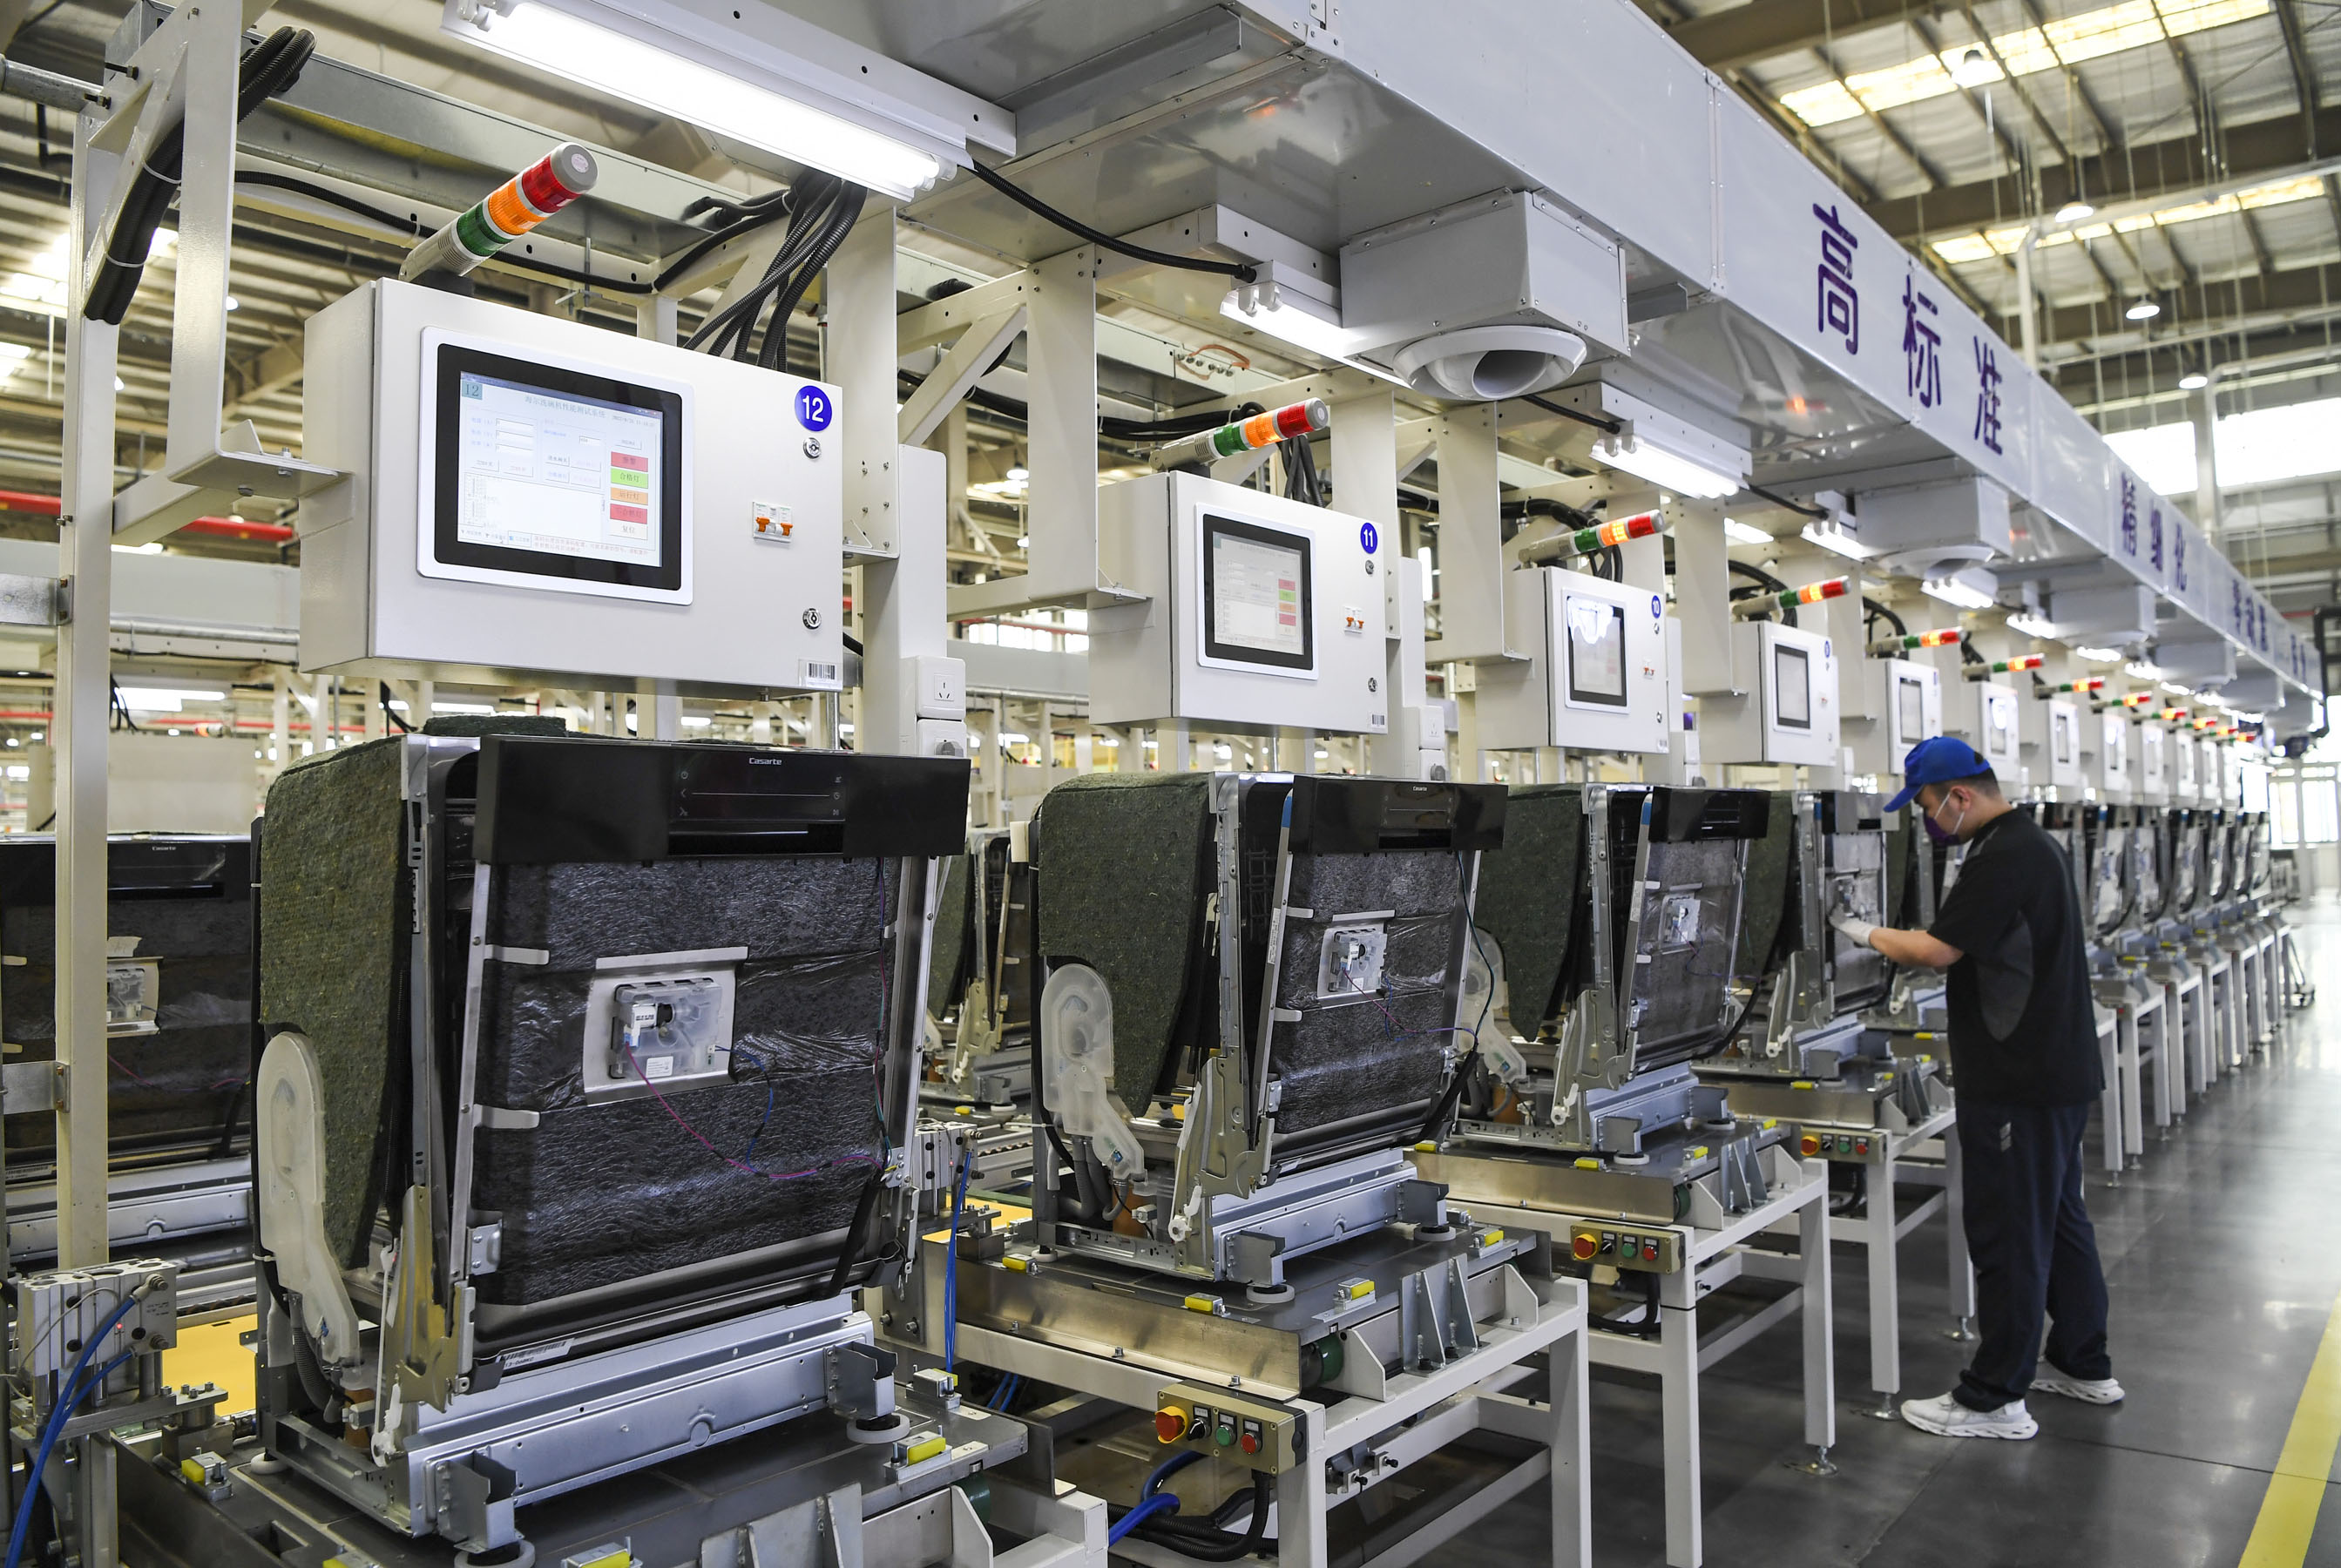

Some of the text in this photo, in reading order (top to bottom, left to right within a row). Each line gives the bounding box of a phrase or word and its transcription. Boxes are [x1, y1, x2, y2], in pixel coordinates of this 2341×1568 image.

[1812, 203, 2004, 455] 高标准
[464, 383, 479, 398] 12
[802, 395, 824, 423] 12
[619, 472, 640, 484] 合格灯
[1363, 528, 1374, 548] 11
